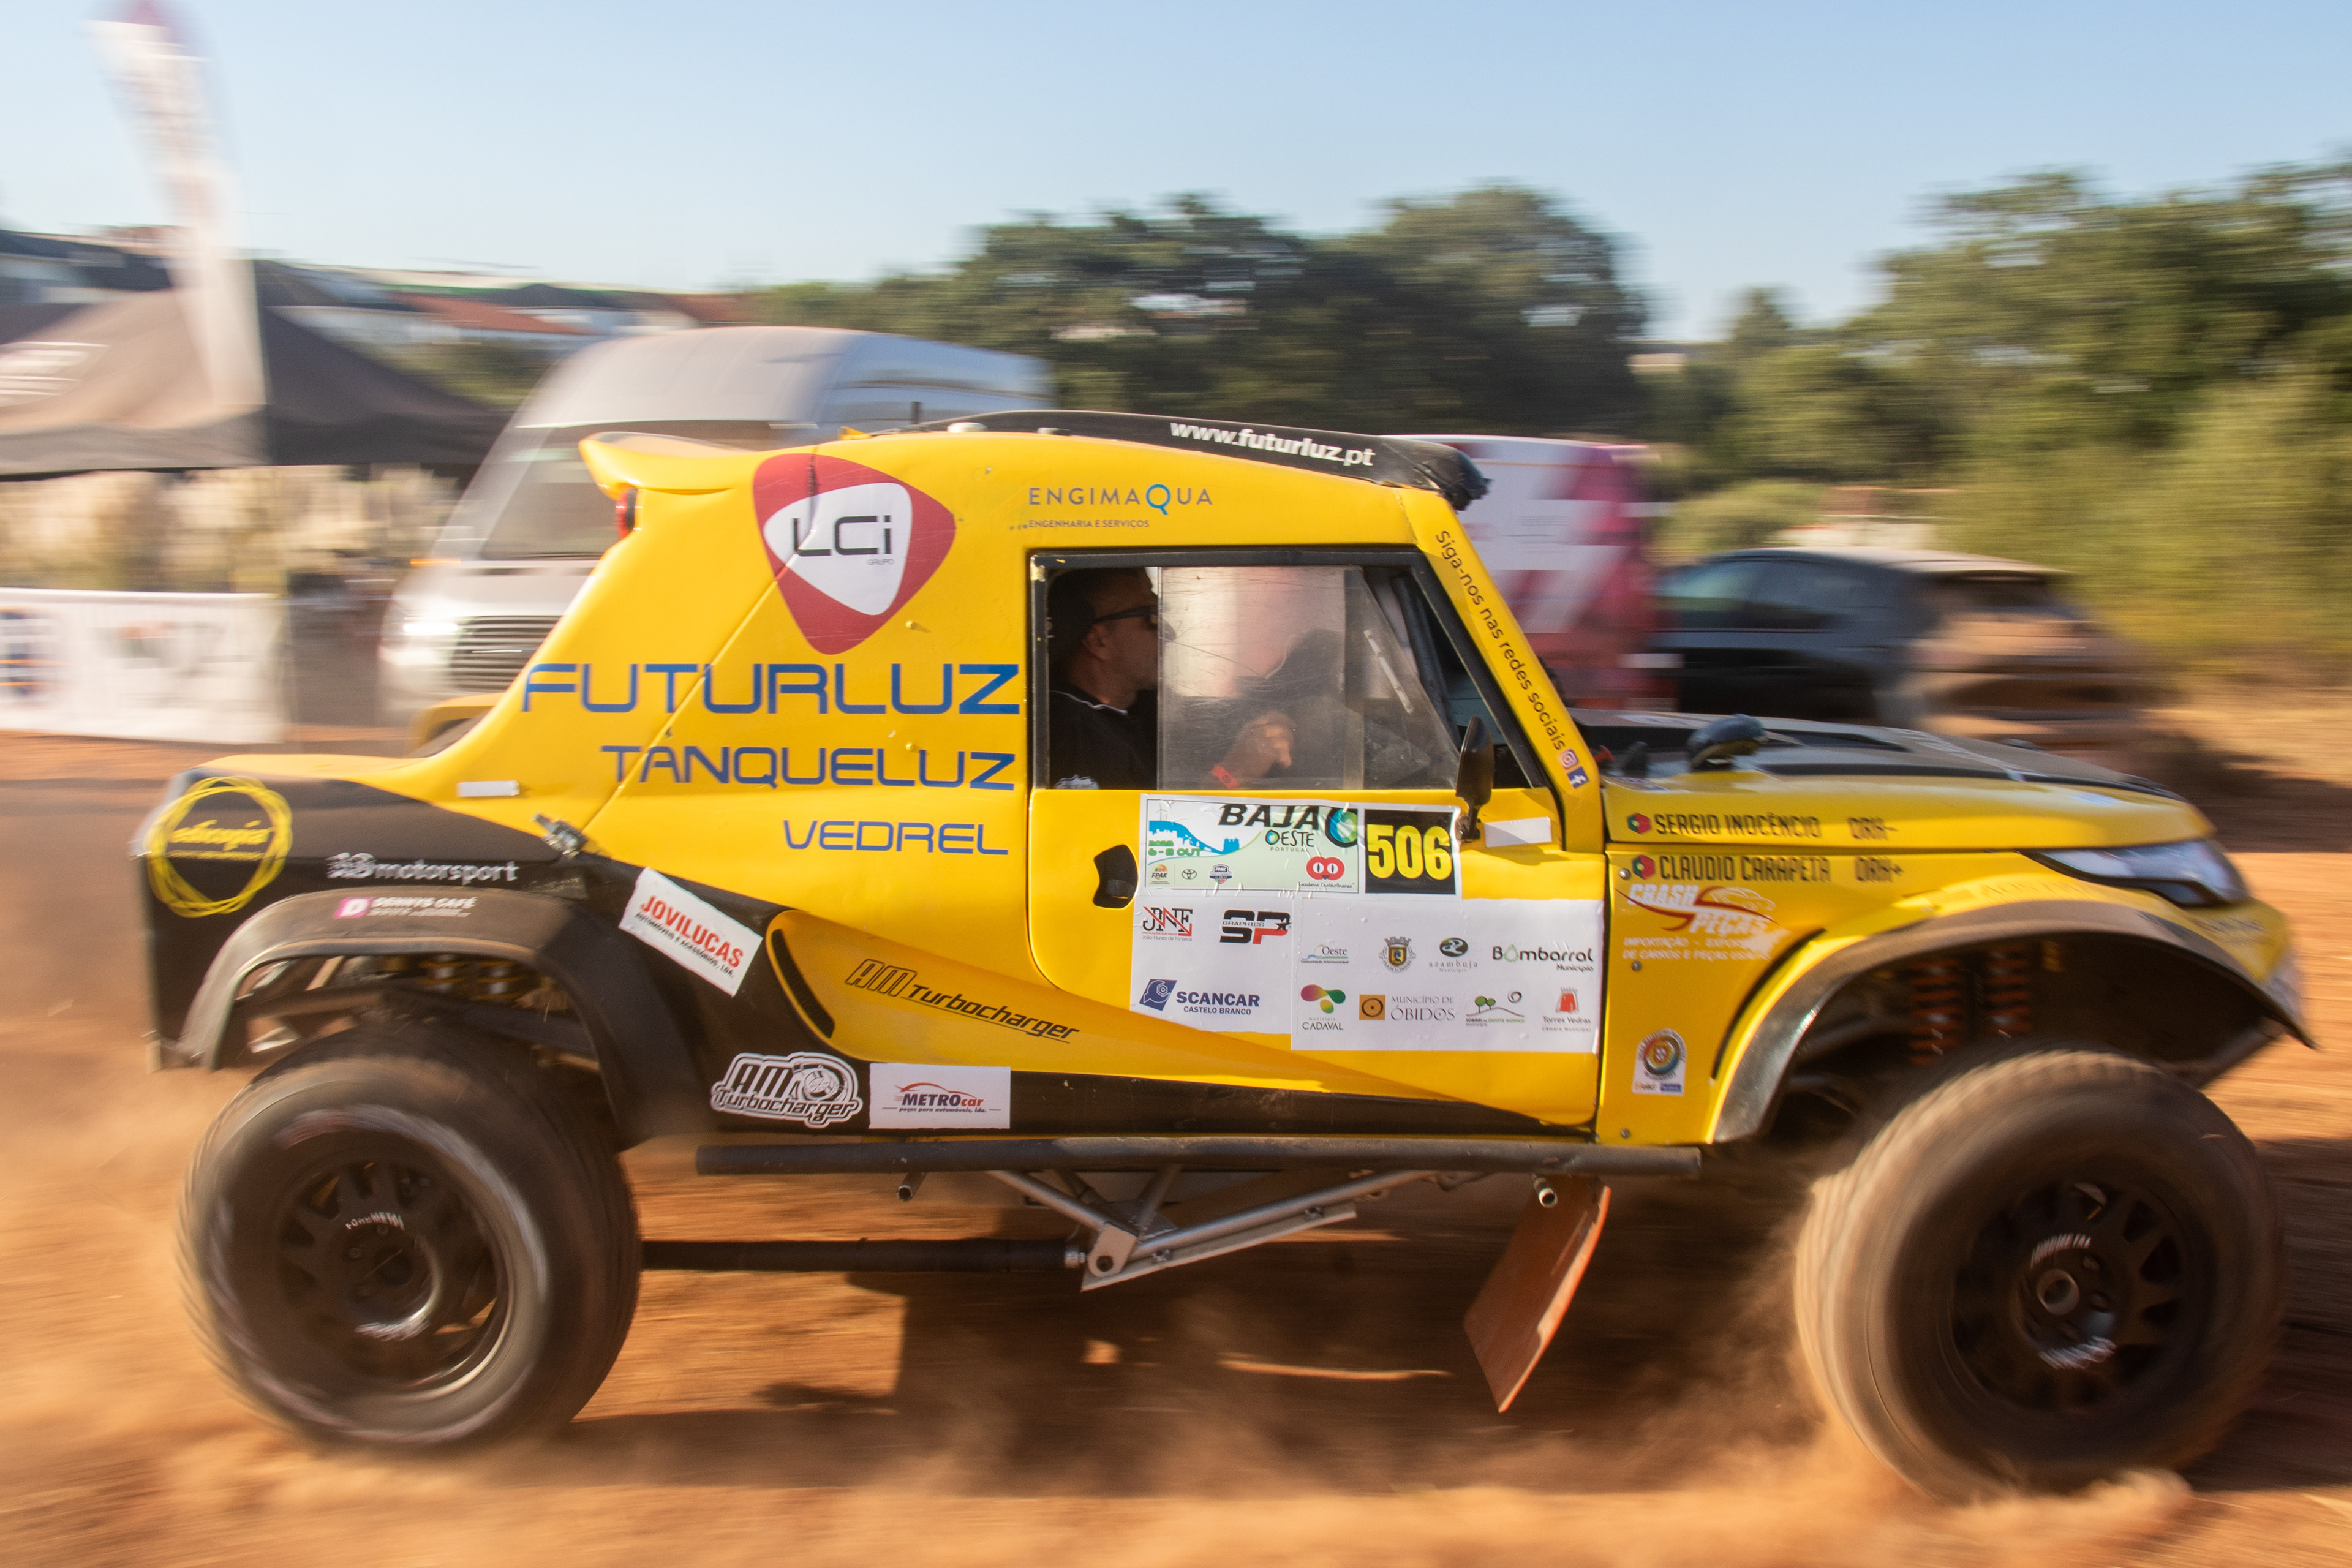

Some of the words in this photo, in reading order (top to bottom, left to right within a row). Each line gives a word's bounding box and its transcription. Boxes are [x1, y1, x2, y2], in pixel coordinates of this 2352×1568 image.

[1170, 423, 1376, 466] www.futurluz.pt
[1028, 484, 1213, 515] ENGIMAQUA
[1029, 519, 1092, 528] ENGENHARIA
[1102, 519, 1150, 529] SERVIÇOS
[1436, 530, 1484, 605] Siga-nos
[1480, 606, 1504, 639] nas
[1499, 641, 1532, 690] redes
[1528, 692, 1566, 750] sociais
[522, 663, 1020, 715] FUTURLUZ
[600, 745, 1016, 791] TANQUELUZ
[1218, 803, 1320, 830] BAJA
[1654, 813, 1720, 835] SERGIO
[783, 820, 1008, 856] VEDREL
[1265, 829, 1314, 847] OESTE
[1367, 824, 1452, 880] 506
[1659, 856, 1735, 881] CLAUDIO
[1741, 856, 1831, 881] CARAPETA
[1628, 883, 1699, 907] CRASH
[640, 895, 744, 967] JOVILUCAS
[1322, 946, 1347, 955] Oeste
[1492, 944, 1594, 962] Bombarral
[1428, 959, 1478, 968] azambuja
[1176, 991, 1260, 1007] SCANCAR
[1392, 995, 1439, 1004] MUNICÍPIO
[907, 984, 1080, 1039] Turbocharger
[1391, 1005, 1455, 1020] ÓBIDOS
[1302, 1022, 1343, 1030] CADAVAL
[714, 1088, 856, 1121] Turbocharger
[902, 1093, 984, 1106] METROcar
